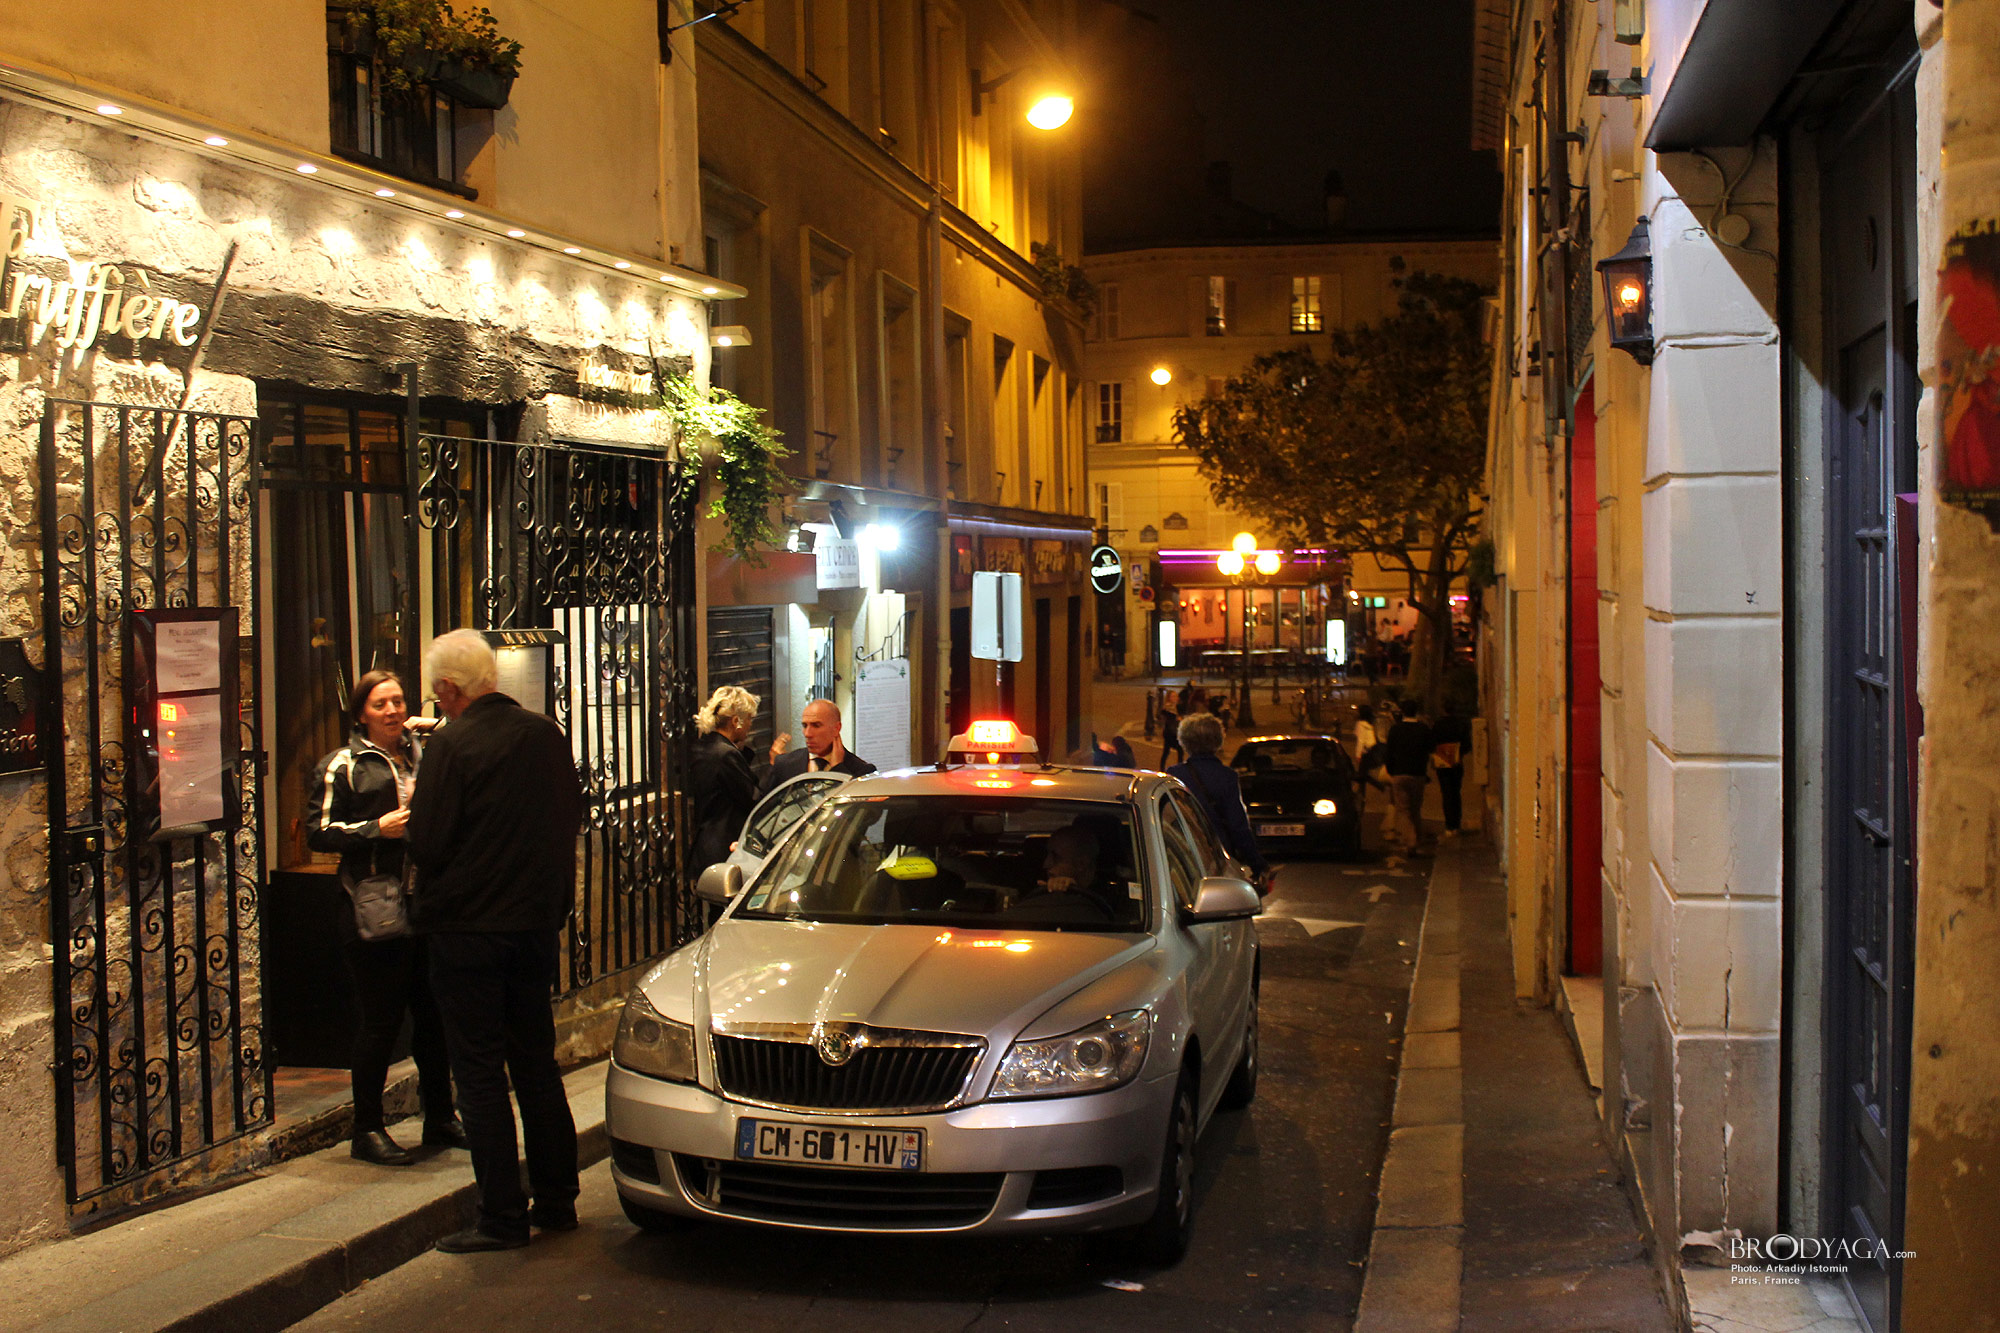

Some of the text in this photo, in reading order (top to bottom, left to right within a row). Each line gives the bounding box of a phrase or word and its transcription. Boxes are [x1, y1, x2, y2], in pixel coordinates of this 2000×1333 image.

[501, 631, 548, 644] MENU
[966, 741, 1016, 750] PARISIEN
[743, 1142, 751, 1151] F
[902, 1152, 918, 1167] 75
